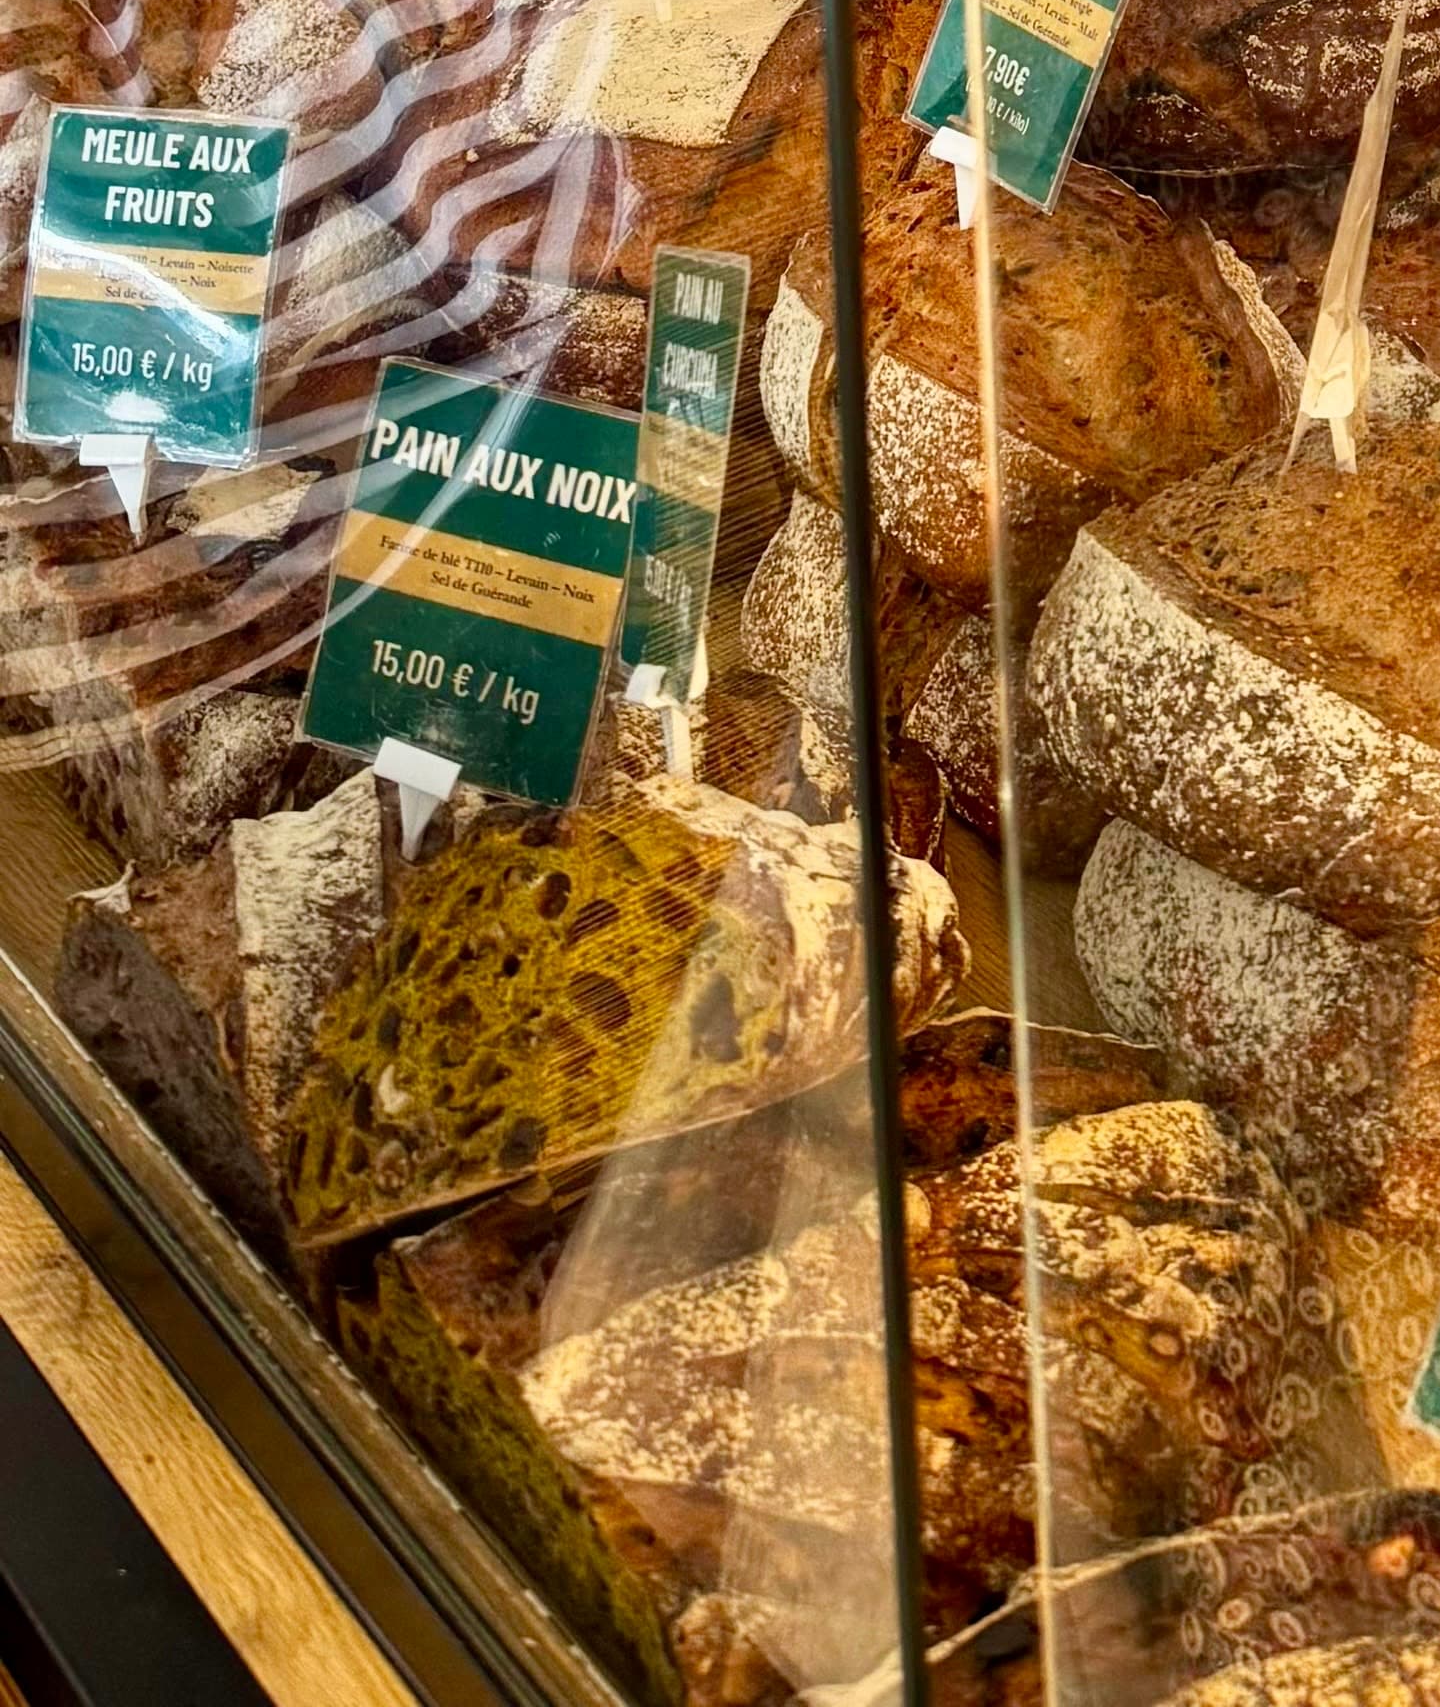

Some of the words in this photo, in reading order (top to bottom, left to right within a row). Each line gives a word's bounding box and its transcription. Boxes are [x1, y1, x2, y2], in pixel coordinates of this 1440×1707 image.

[81, 127, 186, 170] MEULE
[188, 134, 256, 175] AUX
[104, 185, 216, 229] FRUITS
[158, 256, 196, 271] Levain
[207, 259, 255, 276] Noisette
[189, 274, 217, 289] Noix
[105, 285, 123, 299] Sel
[123, 287, 138, 300] de
[673, 271, 704, 322] PAIN
[72, 341, 135, 380] 15,00
[139, 349, 159, 381] €
[161, 351, 177, 382] /
[182, 352, 214, 394] kg
[370, 418, 463, 480] PAIN
[463, 443, 544, 501] AUX
[545, 462, 638, 525] NOIX
[423, 545, 440, 562] de
[440, 549, 462, 570] blé
[506, 568, 550, 592] Levain
[562, 582, 596, 604] Noix
[430, 569, 451, 588] Sel
[452, 576, 469, 592] de
[470, 580, 535, 610] Guérande
[371, 639, 447, 690] 15,00
[451, 662, 475, 699] €
[477, 669, 499, 704] /
[502, 674, 541, 727] kg
